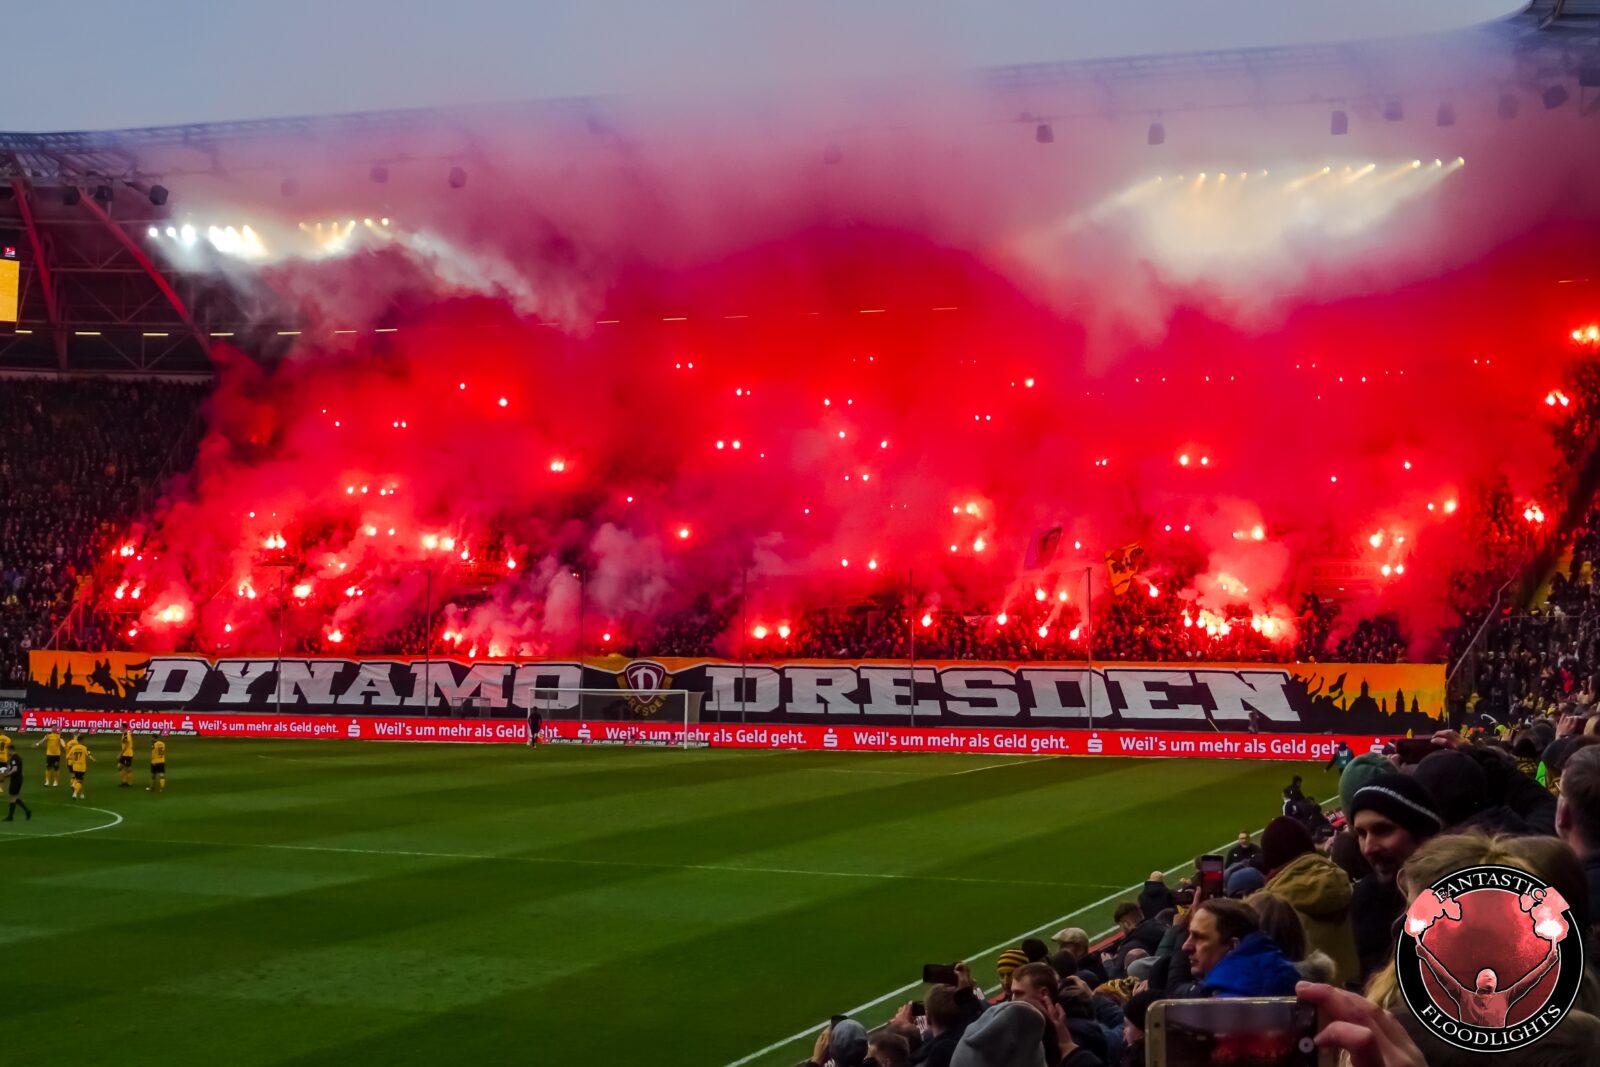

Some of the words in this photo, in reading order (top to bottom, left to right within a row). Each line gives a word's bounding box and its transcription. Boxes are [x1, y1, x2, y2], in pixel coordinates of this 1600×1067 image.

[136, 660, 582, 709] DYNAMO
[705, 667, 1300, 721] DRESDEN
[72, 720, 86, 728] um
[88, 718, 113, 729] mehr
[129, 719, 150, 730] Geld
[198, 720, 227, 731] Weil's
[229, 723, 245, 731] um
[247, 721, 272, 732] mehr
[273, 722, 288, 732] als
[289, 722, 312, 733] Geld
[313, 723, 339, 735] geht.
[374, 722, 412, 736] Weil's
[415, 726, 435, 736] um
[438, 723, 472, 737] mehr
[474, 724, 493, 737] als
[496, 725, 525, 738] Geld
[531, 725, 562, 738] eht.
[606, 727, 646, 740] Weil's
[650, 731, 671, 741] um
[674, 728, 710, 742] mehr
[713, 729, 733, 742] als
[736, 730, 767, 743] Geld
[770, 730, 807, 747] geht.
[853, 731, 897, 746] Weil's
[900, 735, 924, 746] um
[927, 733, 966, 747] mehr
[968, 733, 990, 748] als
[993, 734, 1027, 748] Geld
[1030, 735, 1070, 752] geht.
[1120, 737, 1166, 751] Weil's
[1170, 741, 1195, 752] um
[1199, 738, 1240, 753] mehr
[1243, 739, 1267, 754] als
[1270, 739, 1306, 755] Geld
[1310, 740, 1341, 758] geh
